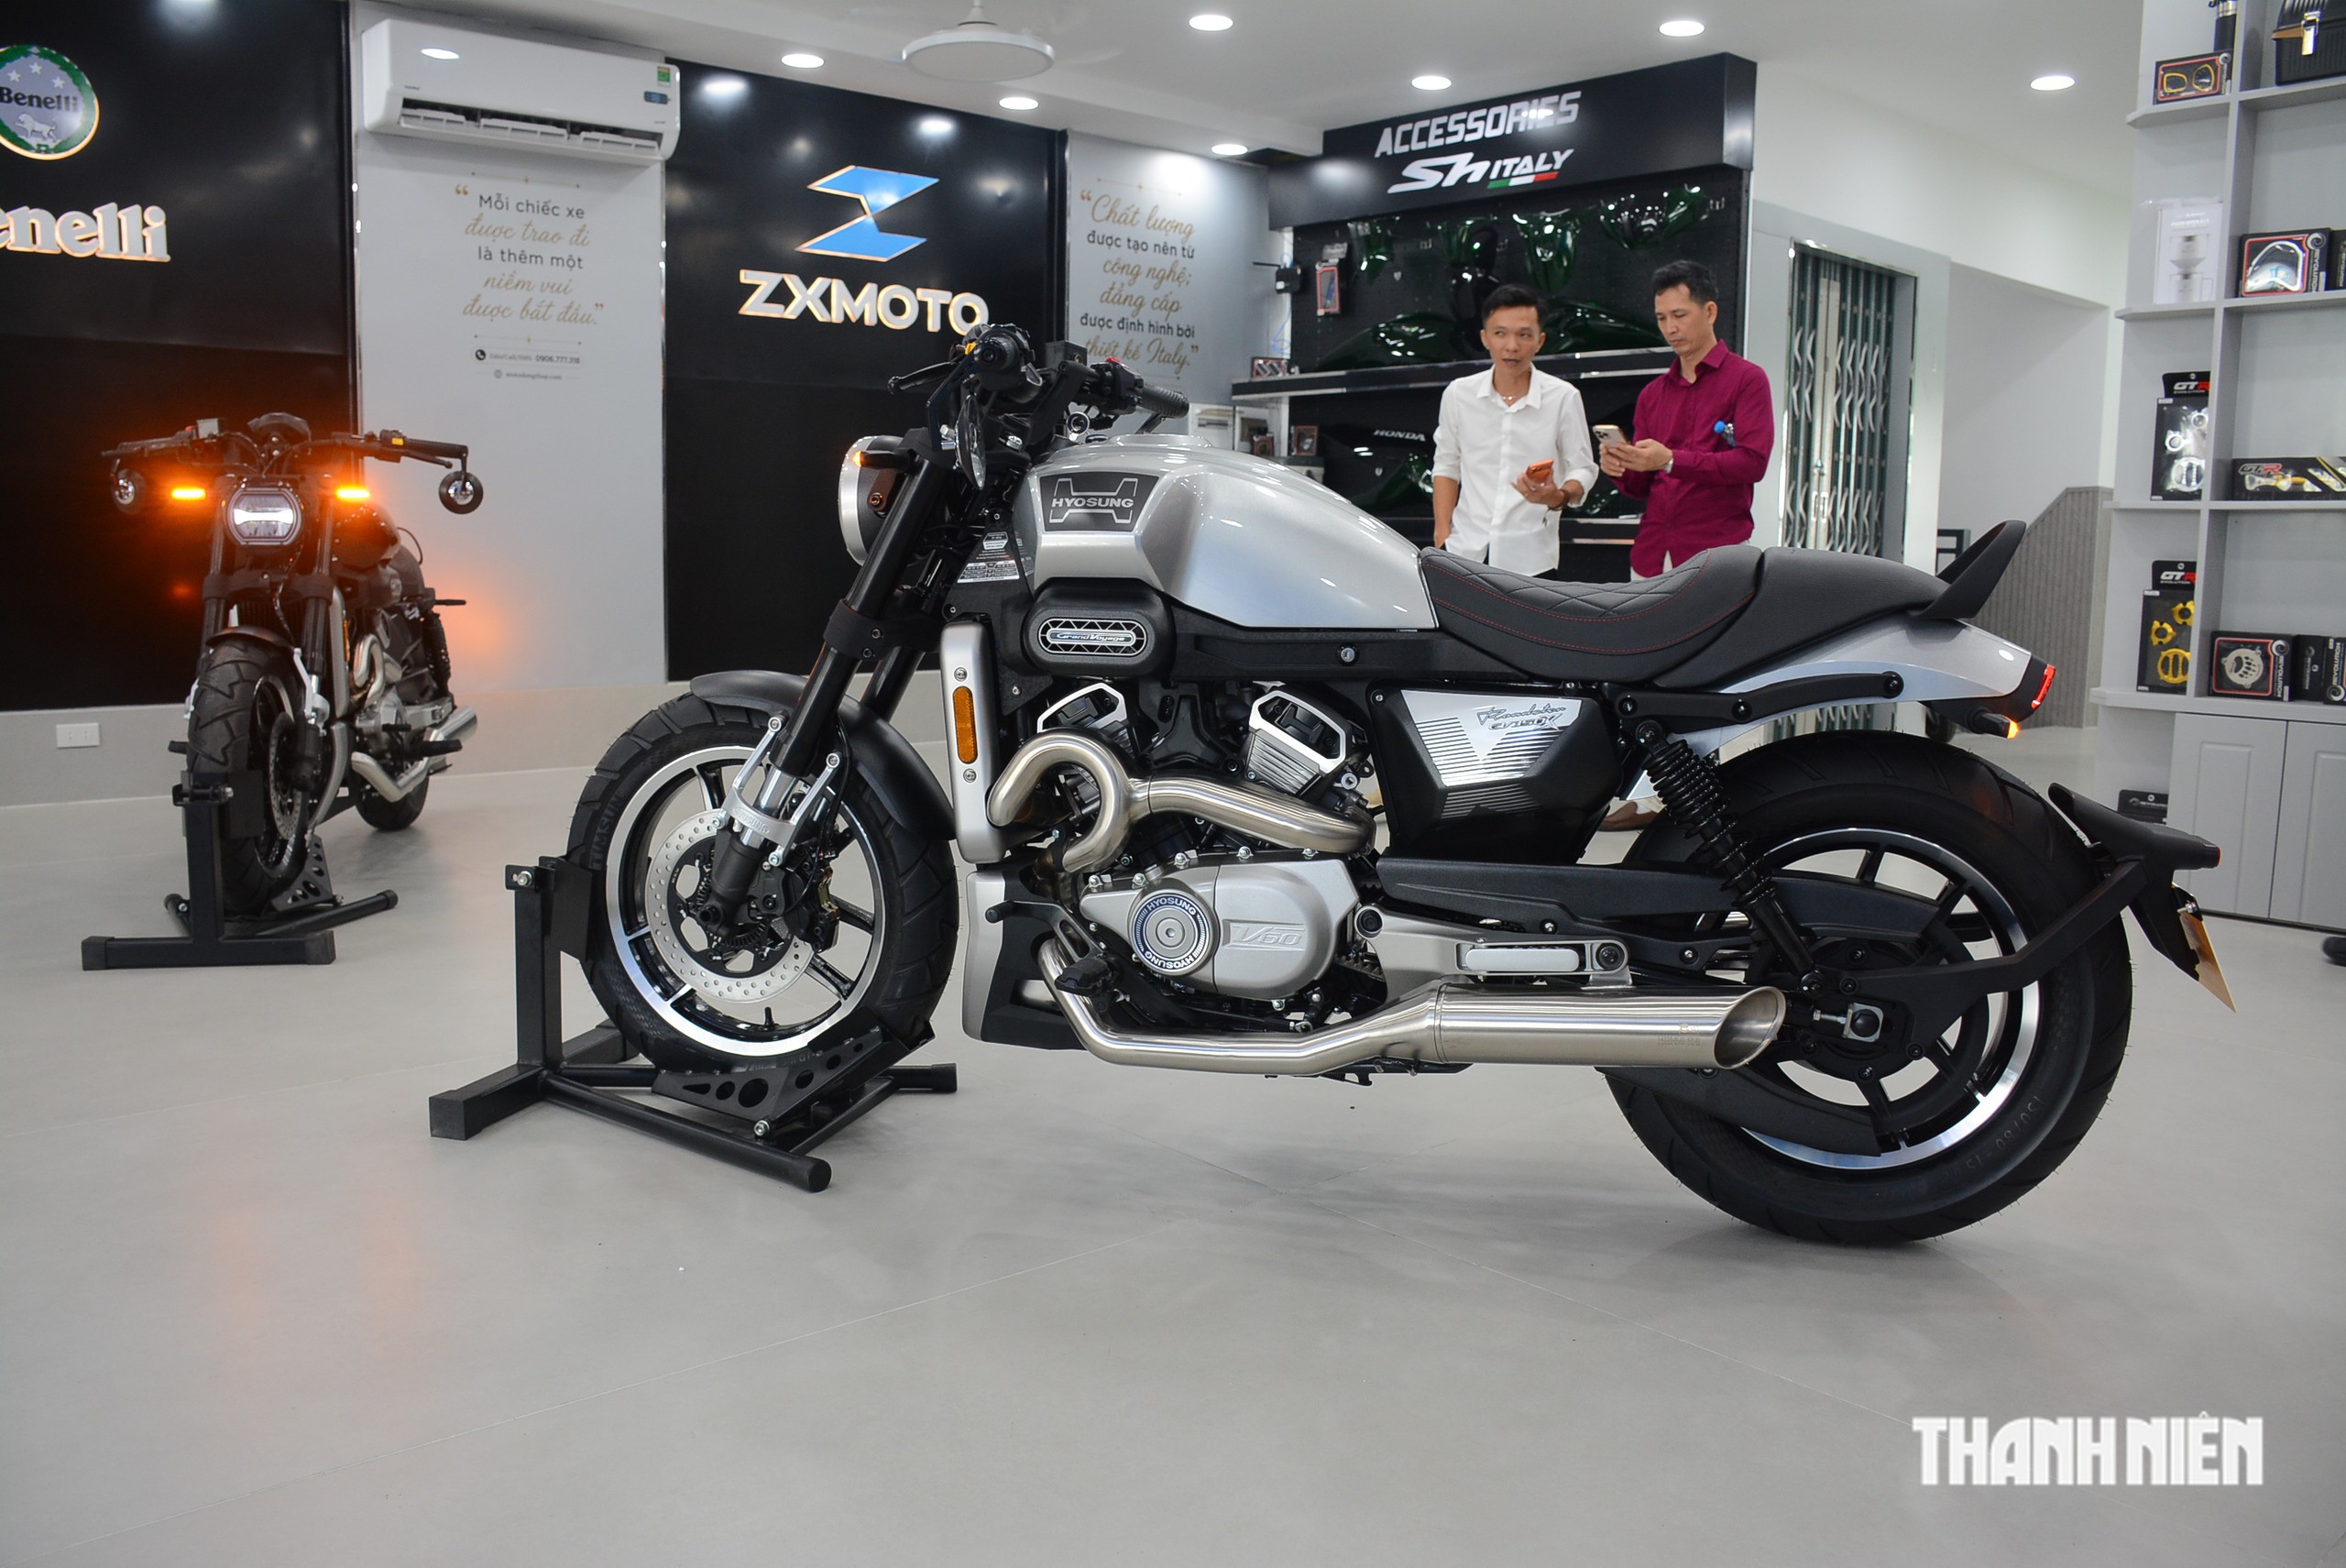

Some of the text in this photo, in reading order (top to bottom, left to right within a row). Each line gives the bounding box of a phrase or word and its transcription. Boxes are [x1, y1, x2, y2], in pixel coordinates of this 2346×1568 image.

[0, 86, 78, 112] Benelli
[1374, 91, 1582, 158] ACCESSORIES
[1489, 148, 1574, 179] ITALY
[515, 199, 560, 216] chiếc
[565, 207, 585, 219] xe
[0, 202, 171, 262] nelli
[465, 213, 591, 247] được trao đi
[1146, 204, 1195, 245] lượng
[1087, 230, 1195, 258] được tạo nên từ
[478, 246, 583, 271] là thêm một
[1102, 258, 1143, 287] công
[539, 280, 574, 295] vui
[463, 293, 513, 322] được
[739, 269, 990, 336] ZXMOTO
[1151, 291, 1182, 322] cấp
[1080, 313, 1195, 338] được định hình bởi
[1373, 430, 1426, 442] HONDA
[1051, 498, 1134, 509] HYOSUNG
[2160, 571, 2197, 584] GTR
[1146, 897, 1197, 916] HYOSUNG
[1145, 951, 1195, 969] HYOSUNG
